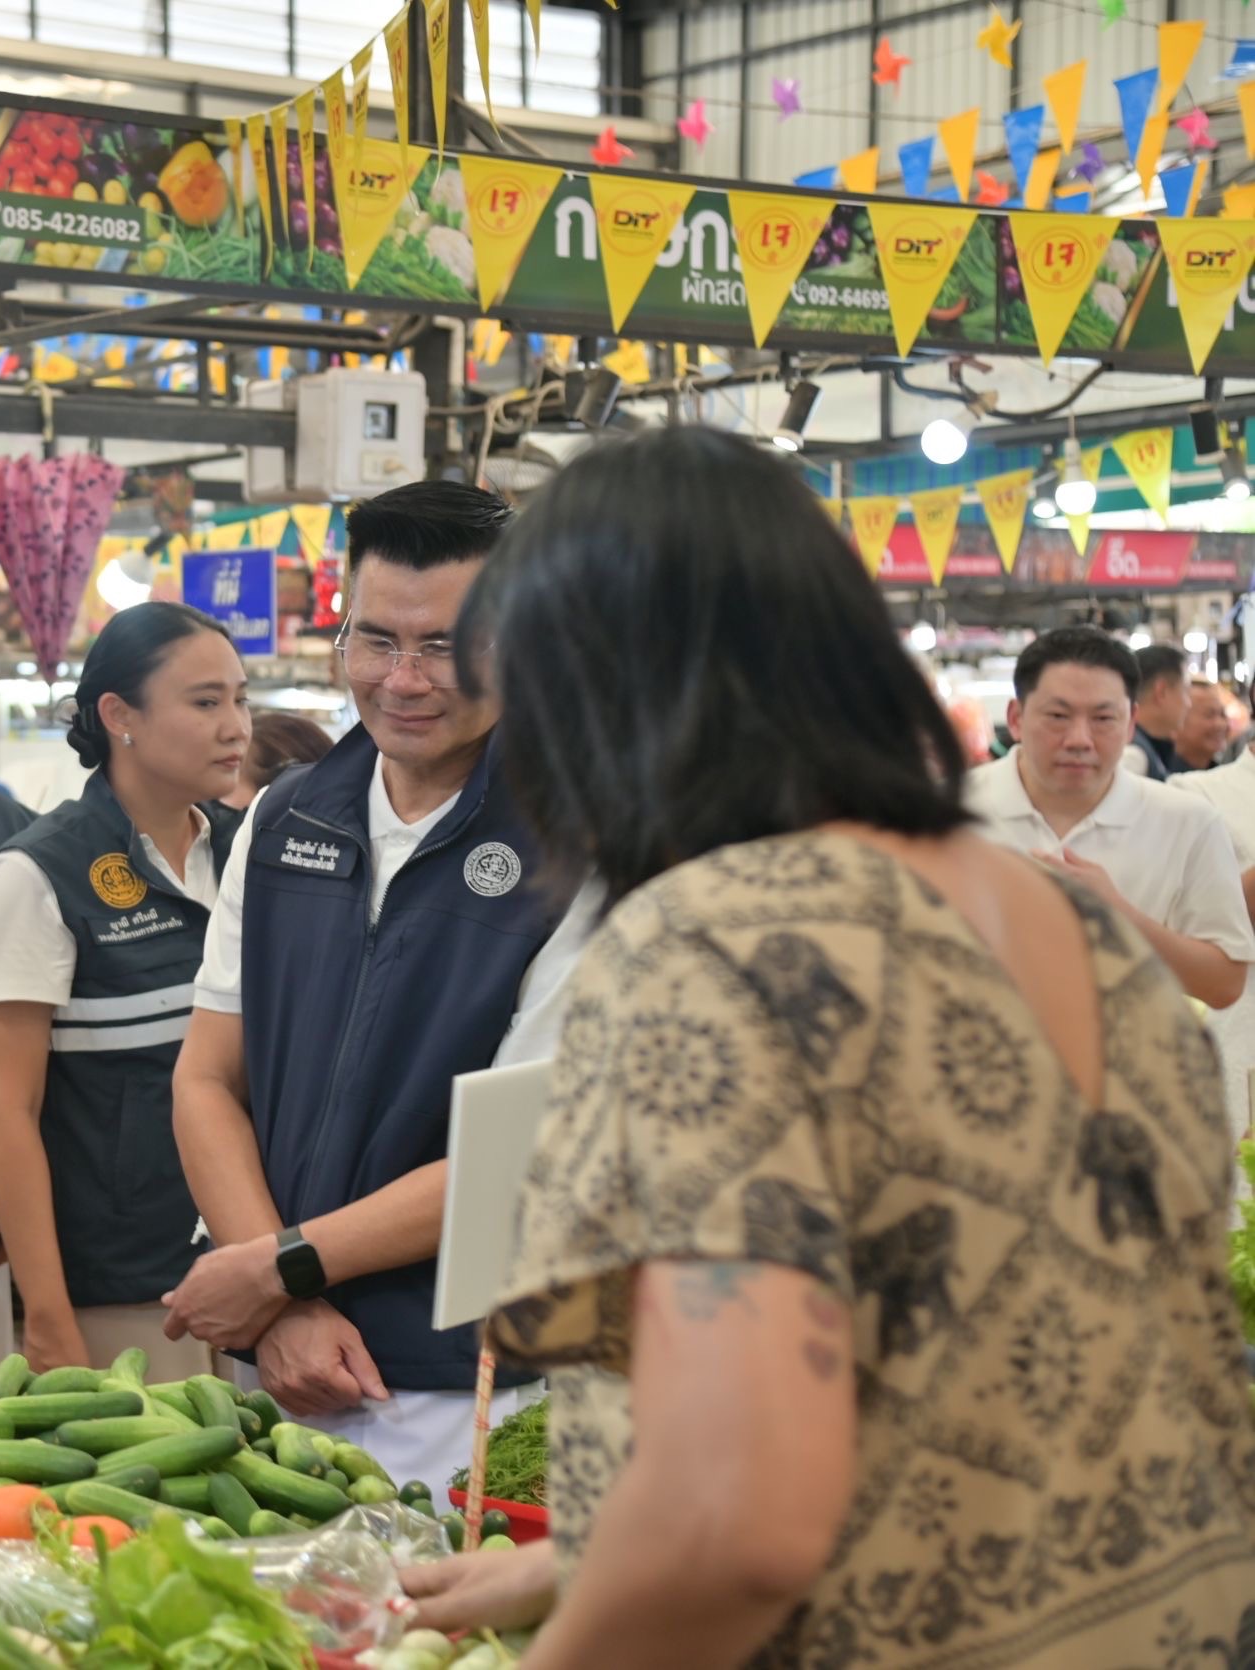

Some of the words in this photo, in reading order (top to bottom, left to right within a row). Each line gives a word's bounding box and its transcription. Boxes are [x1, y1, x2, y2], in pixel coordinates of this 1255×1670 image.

[489, 188, 521, 215] เจ
[2, 206, 141, 242] 085-4226082
[760, 222, 794, 247] เจ
[1044, 241, 1077, 268] เจ
[808, 284, 890, 311] 092-64695
